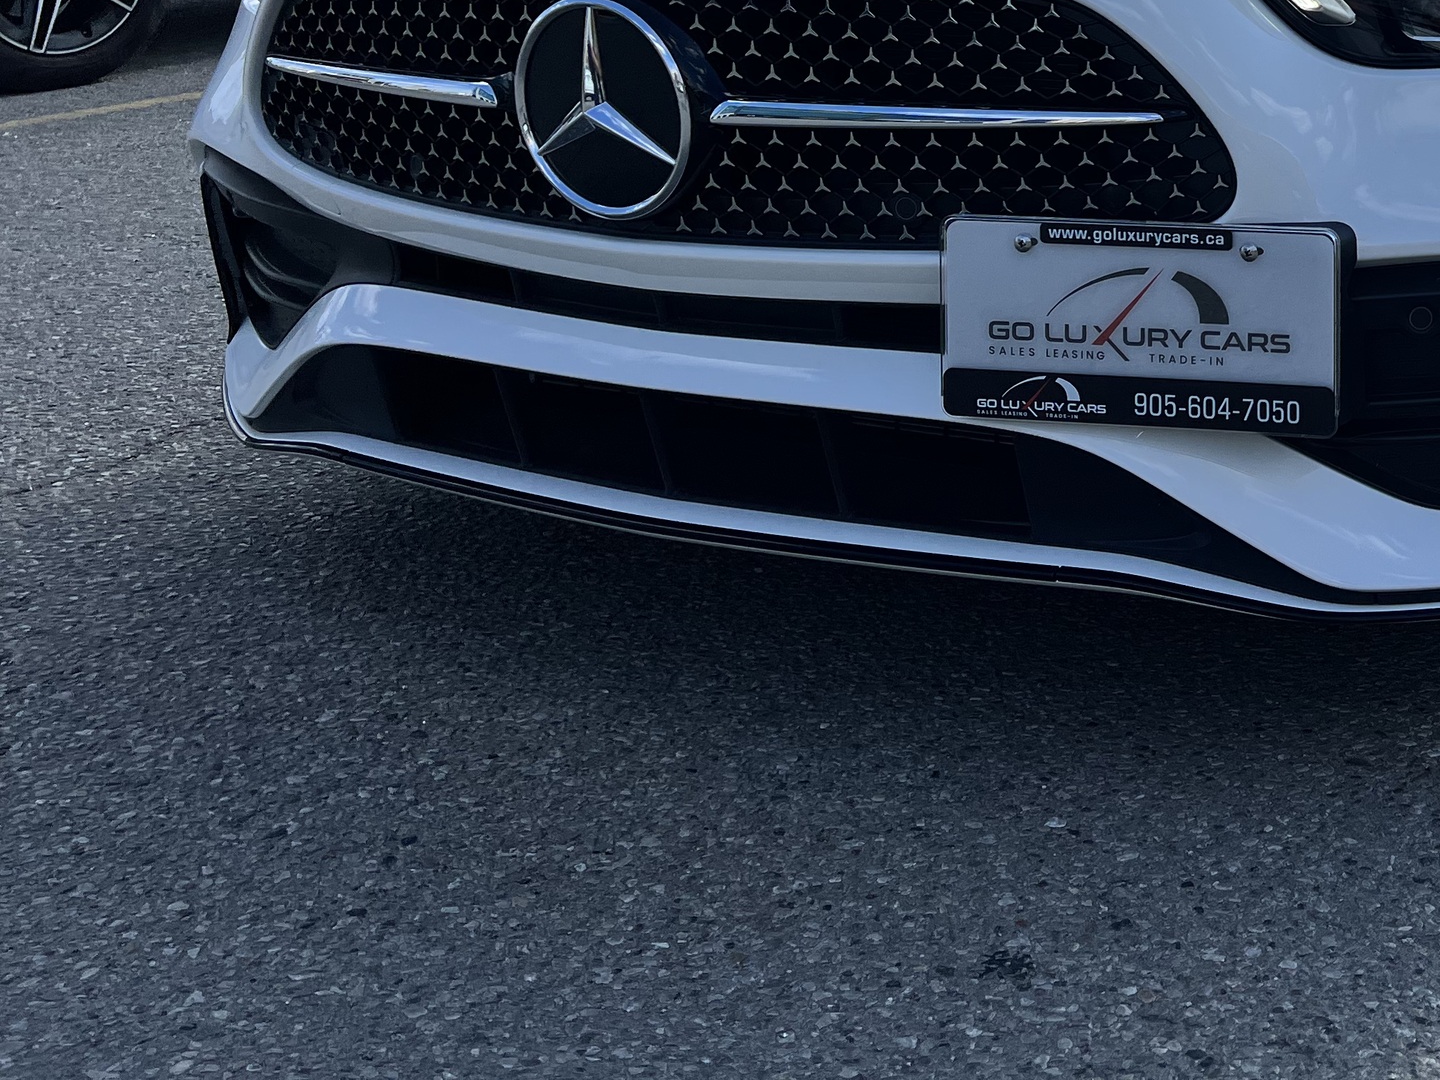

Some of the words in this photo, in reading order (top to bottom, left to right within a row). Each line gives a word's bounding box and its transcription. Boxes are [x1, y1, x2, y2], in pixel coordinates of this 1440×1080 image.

[1048, 227, 1225, 246] www.goluxurycars.ca
[988, 320, 1034, 340] GO
[1045, 323, 1192, 360] LUXURY
[1200, 330, 1291, 354] CARS
[988, 346, 1036, 357] SALES
[1045, 348, 1106, 361] LEASING
[1149, 353, 1225, 366] TRADE-IN
[976, 398, 998, 408] GO
[1001, 400, 1064, 417] LUXURY
[1067, 403, 1107, 414] CARS
[1134, 392, 1300, 424] 905-604-7050
